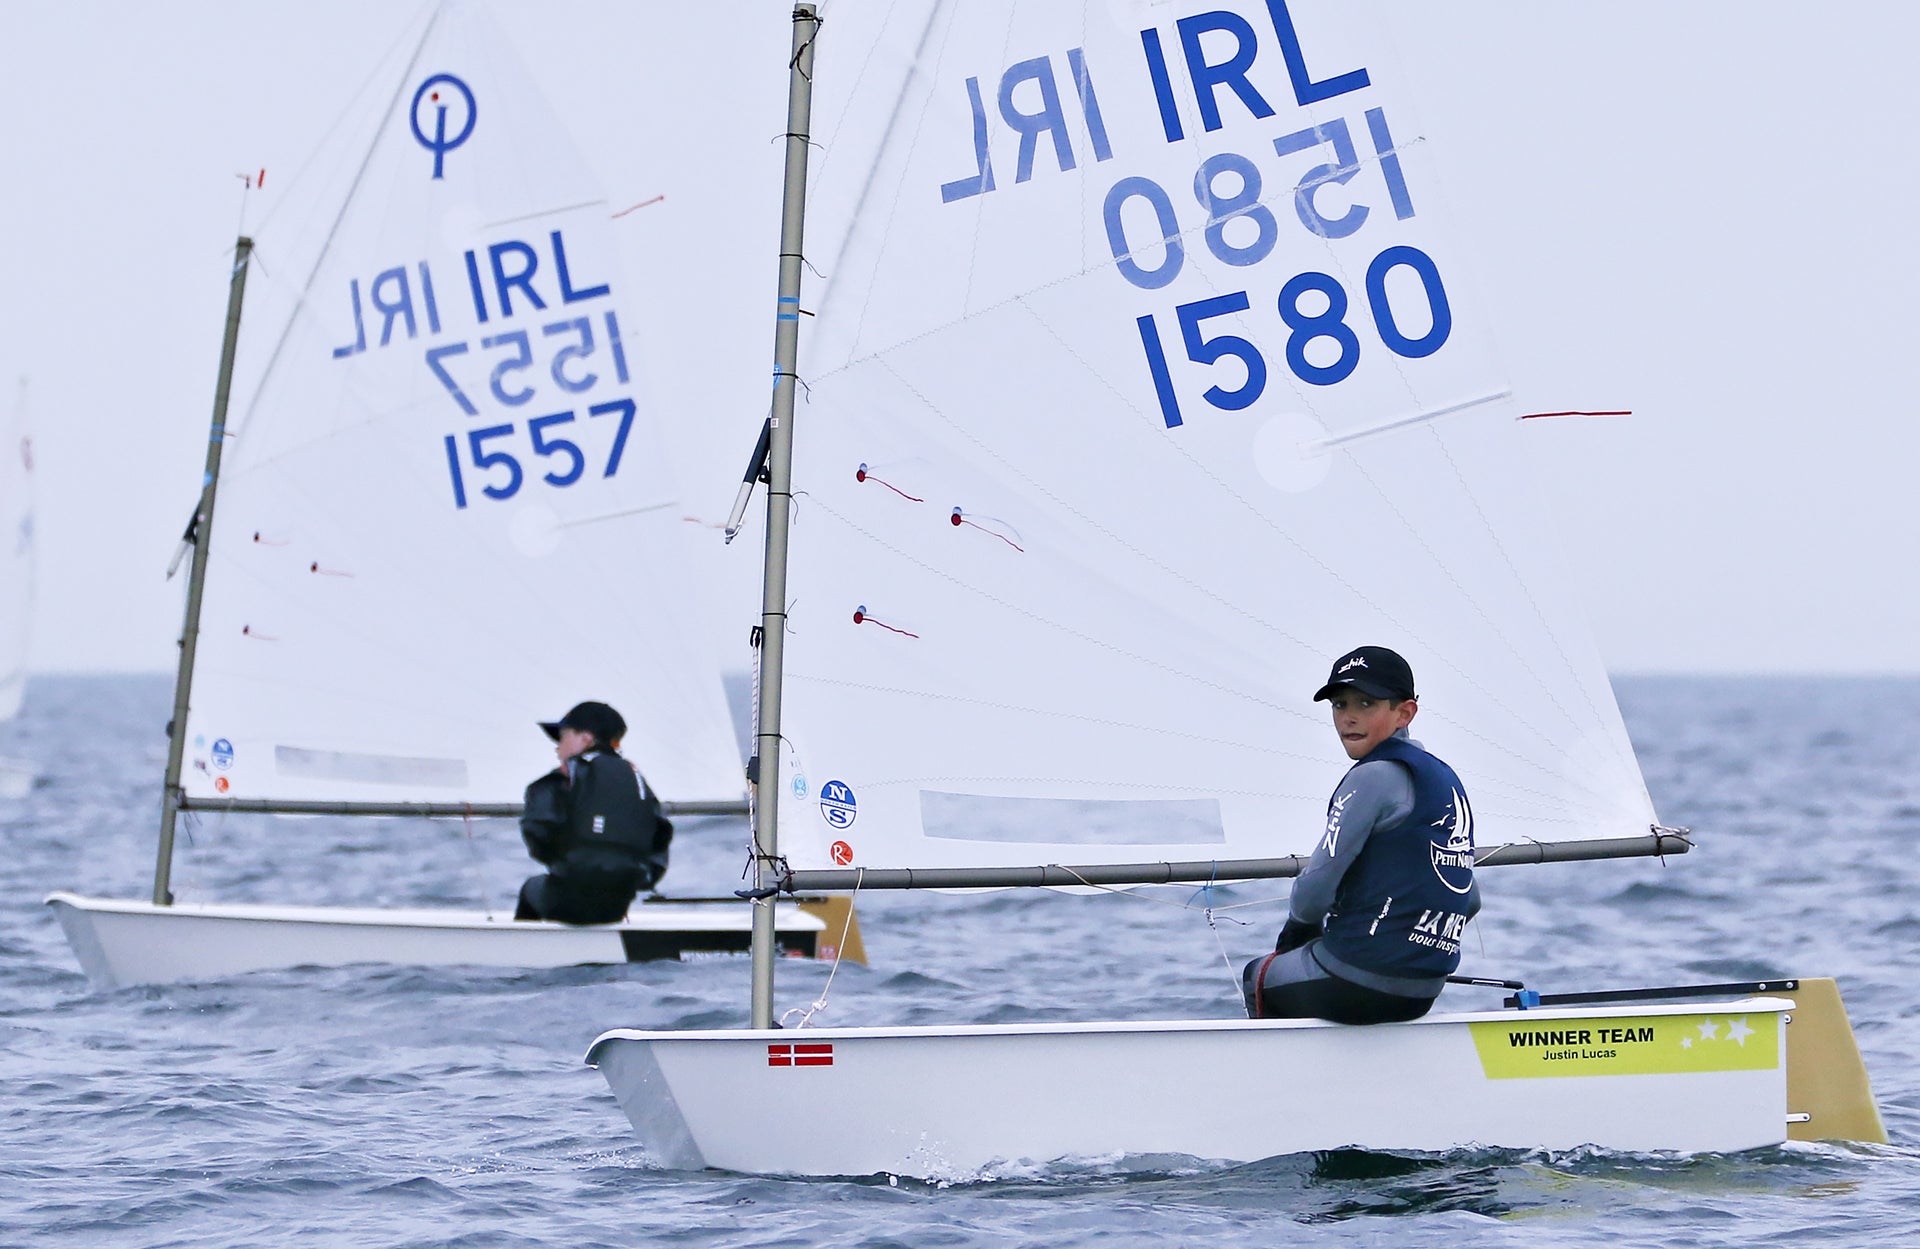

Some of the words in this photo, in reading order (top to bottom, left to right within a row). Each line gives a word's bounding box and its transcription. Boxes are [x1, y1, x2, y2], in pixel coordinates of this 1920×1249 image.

[1140, 0, 1371, 143] IRL
[464, 230, 611, 323] IRL
[1136, 245, 1452, 428] 1580
[444, 398, 637, 509] 1557
[1408, 932, 1437, 947] vous
[1413, 909, 1444, 936] LA
[1509, 1030, 1592, 1047] WINNER
[1598, 1027, 1654, 1044] TEAM
[1542, 1049, 1579, 1061] Justin
[1582, 1048, 1617, 1059] Lucas
